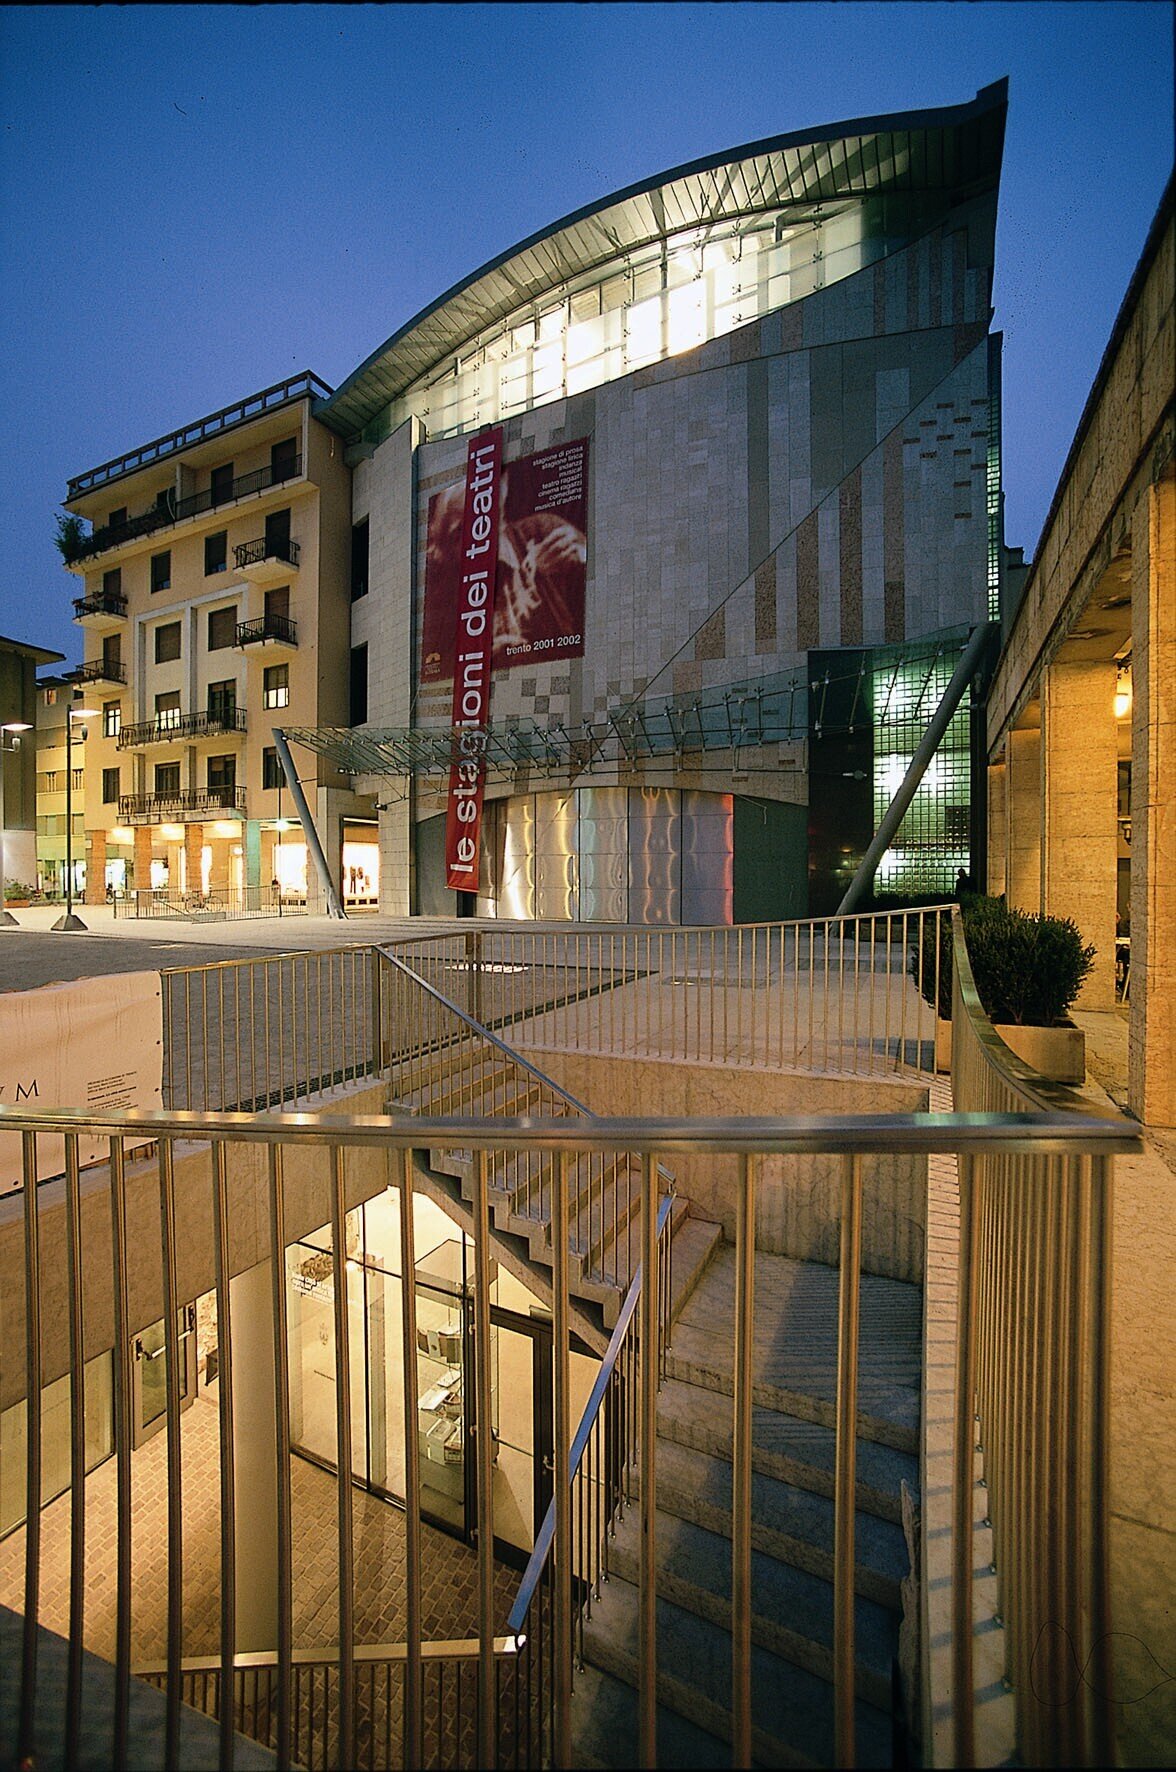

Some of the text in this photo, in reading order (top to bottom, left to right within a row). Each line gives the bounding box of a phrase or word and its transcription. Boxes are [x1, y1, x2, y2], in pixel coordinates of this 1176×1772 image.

[533, 454, 557, 466] stagione
[565, 446, 583, 456] prosa
[542, 453, 583, 470] stagione lirica
[559, 465, 583, 478] musical
[538, 479, 583, 497] cinema ragazzi
[542, 472, 583, 490] teatro ragazzi
[534, 494, 582, 512] musica d'autore
[506, 634, 581, 656] trento 2001 2002
[450, 443, 495, 873] le stagioni dei teatri
